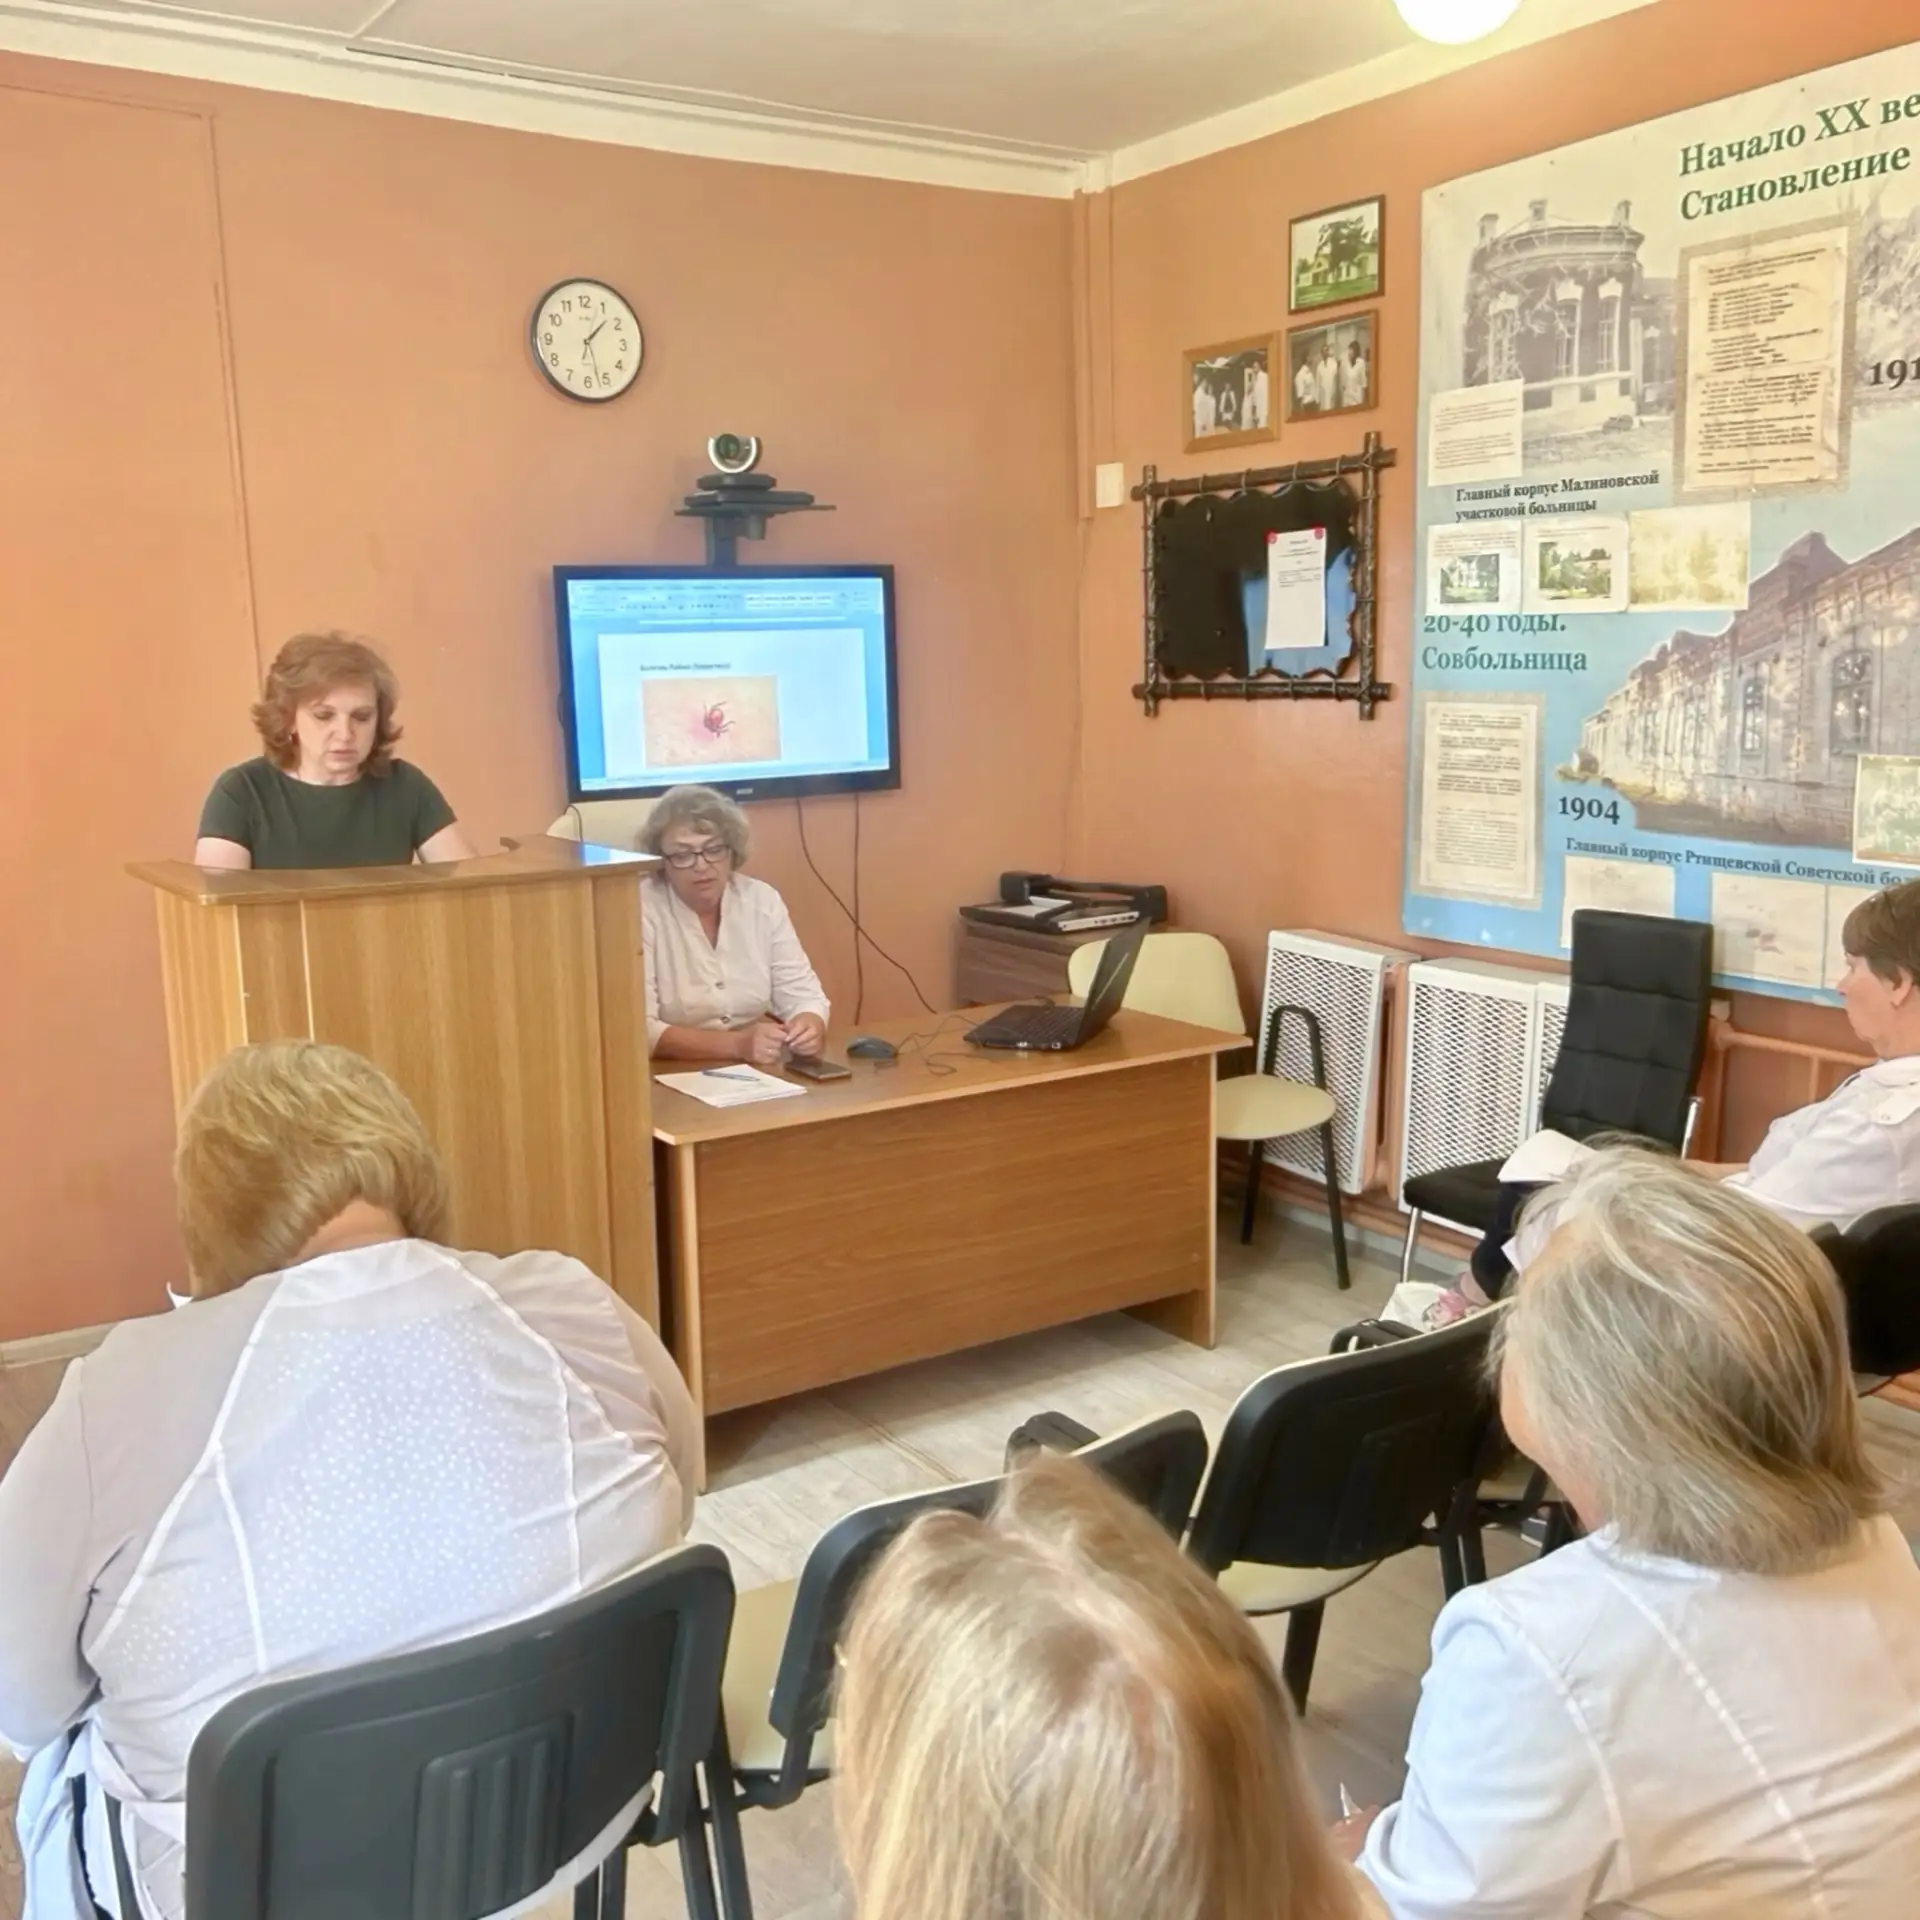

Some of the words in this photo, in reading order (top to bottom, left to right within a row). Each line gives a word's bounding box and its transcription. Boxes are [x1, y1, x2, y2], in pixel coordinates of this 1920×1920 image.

[1679, 124, 1806, 176] Начало
[1680, 145, 1911, 220] Становление
[560, 300, 572, 313] 11
[578, 295, 591, 309] 12
[600, 301, 606, 315] 1
[548, 313, 562, 327] 10
[614, 317, 622, 331] 2
[544, 332, 553, 346] 9
[619, 338, 628, 352] 3
[550, 353, 559, 367] 8
[614, 360, 623, 372] 4
[565, 368, 574, 382] 7
[602, 372, 611, 386] 5
[583, 376, 593, 389] 6
[1456, 484, 1511, 501] Главный
[1513, 484, 1559, 499] корпус
[1561, 470, 1660, 492] Малиновской
[1455, 501, 1526, 523] участковой
[1528, 499, 1597, 516] больницы
[1423, 614, 1490, 639] 20-40
[1422, 645, 1588, 674] Совбольница
[1558, 796, 1620, 825] 1904
[1566, 837, 1629, 856] Главный
[1631, 846, 1683, 864] корпус
[1685, 850, 1781, 873] Ртищевской
[1785, 860, 1876, 885] Советской
[1879, 871, 1909, 886] бо
